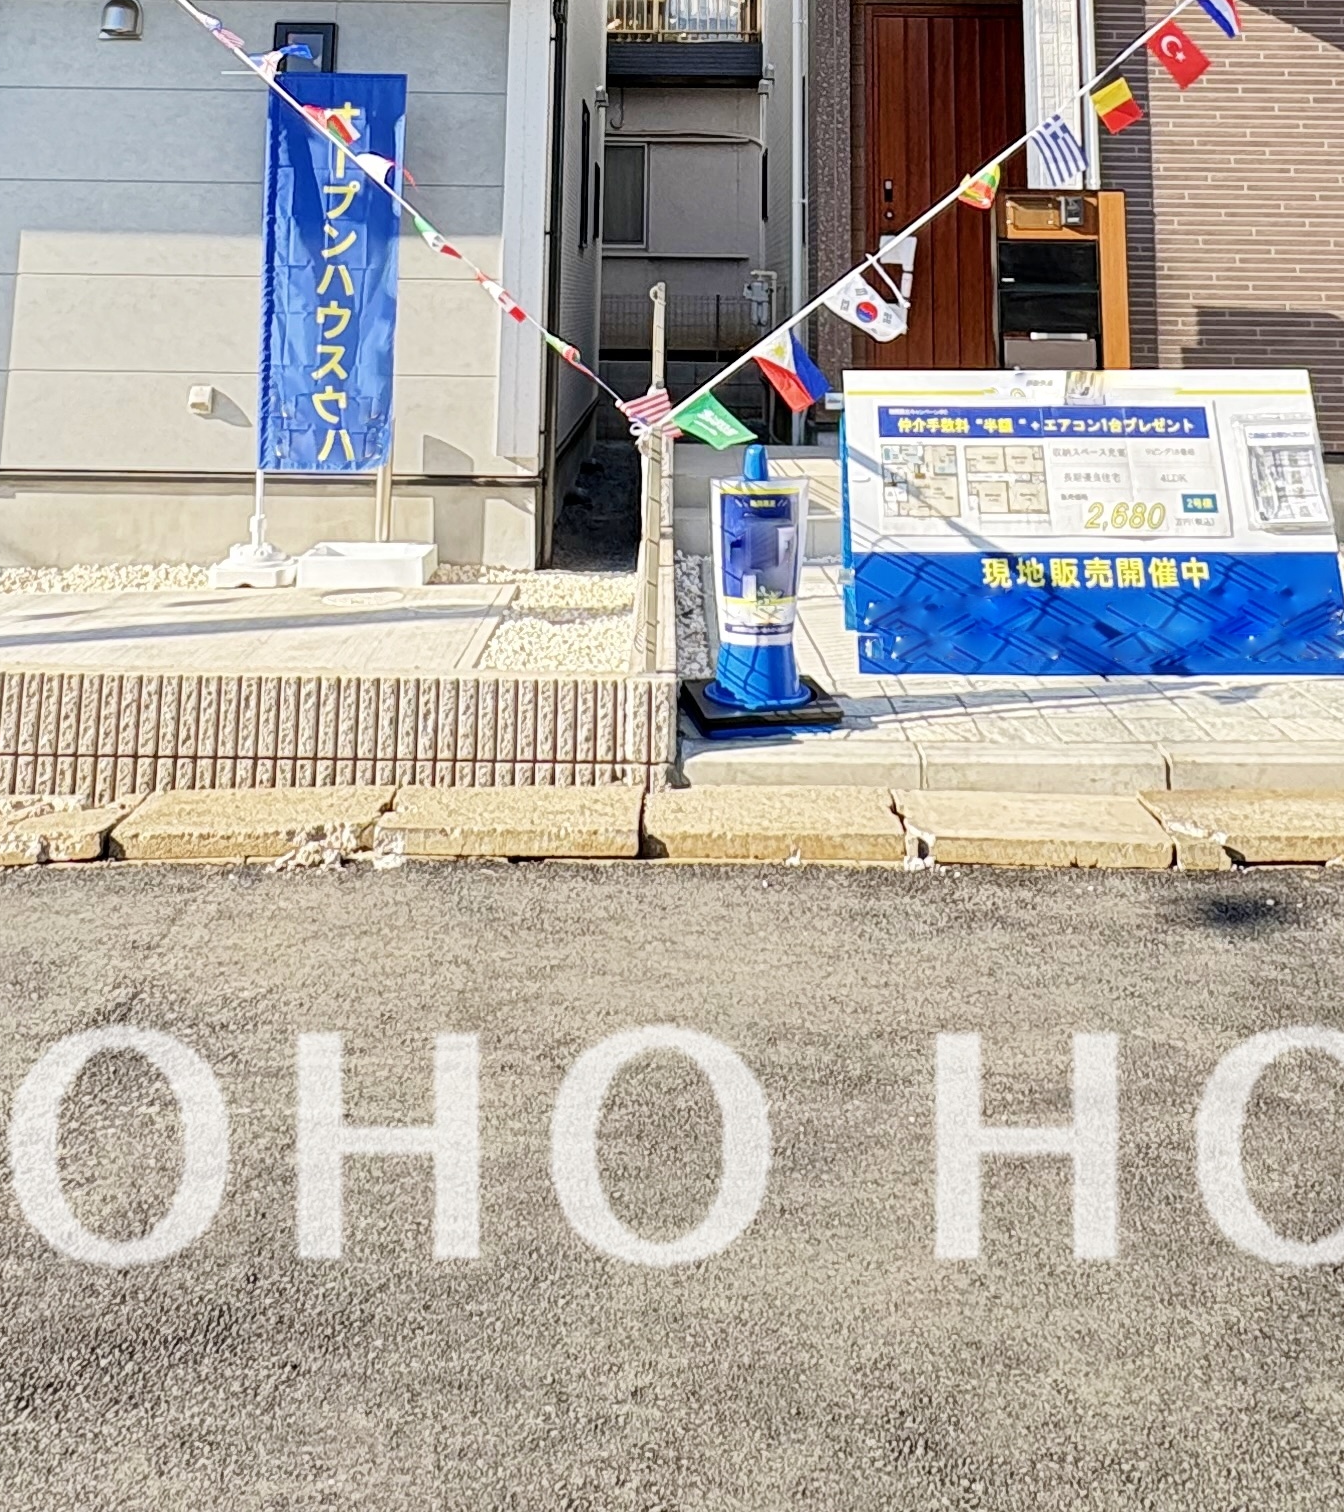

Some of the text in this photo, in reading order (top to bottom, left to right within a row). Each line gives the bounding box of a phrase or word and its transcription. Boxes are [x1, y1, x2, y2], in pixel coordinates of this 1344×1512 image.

[1084, 502, 1166, 531] 2,680
[981, 557, 1210, 588] 現地販売開催中
